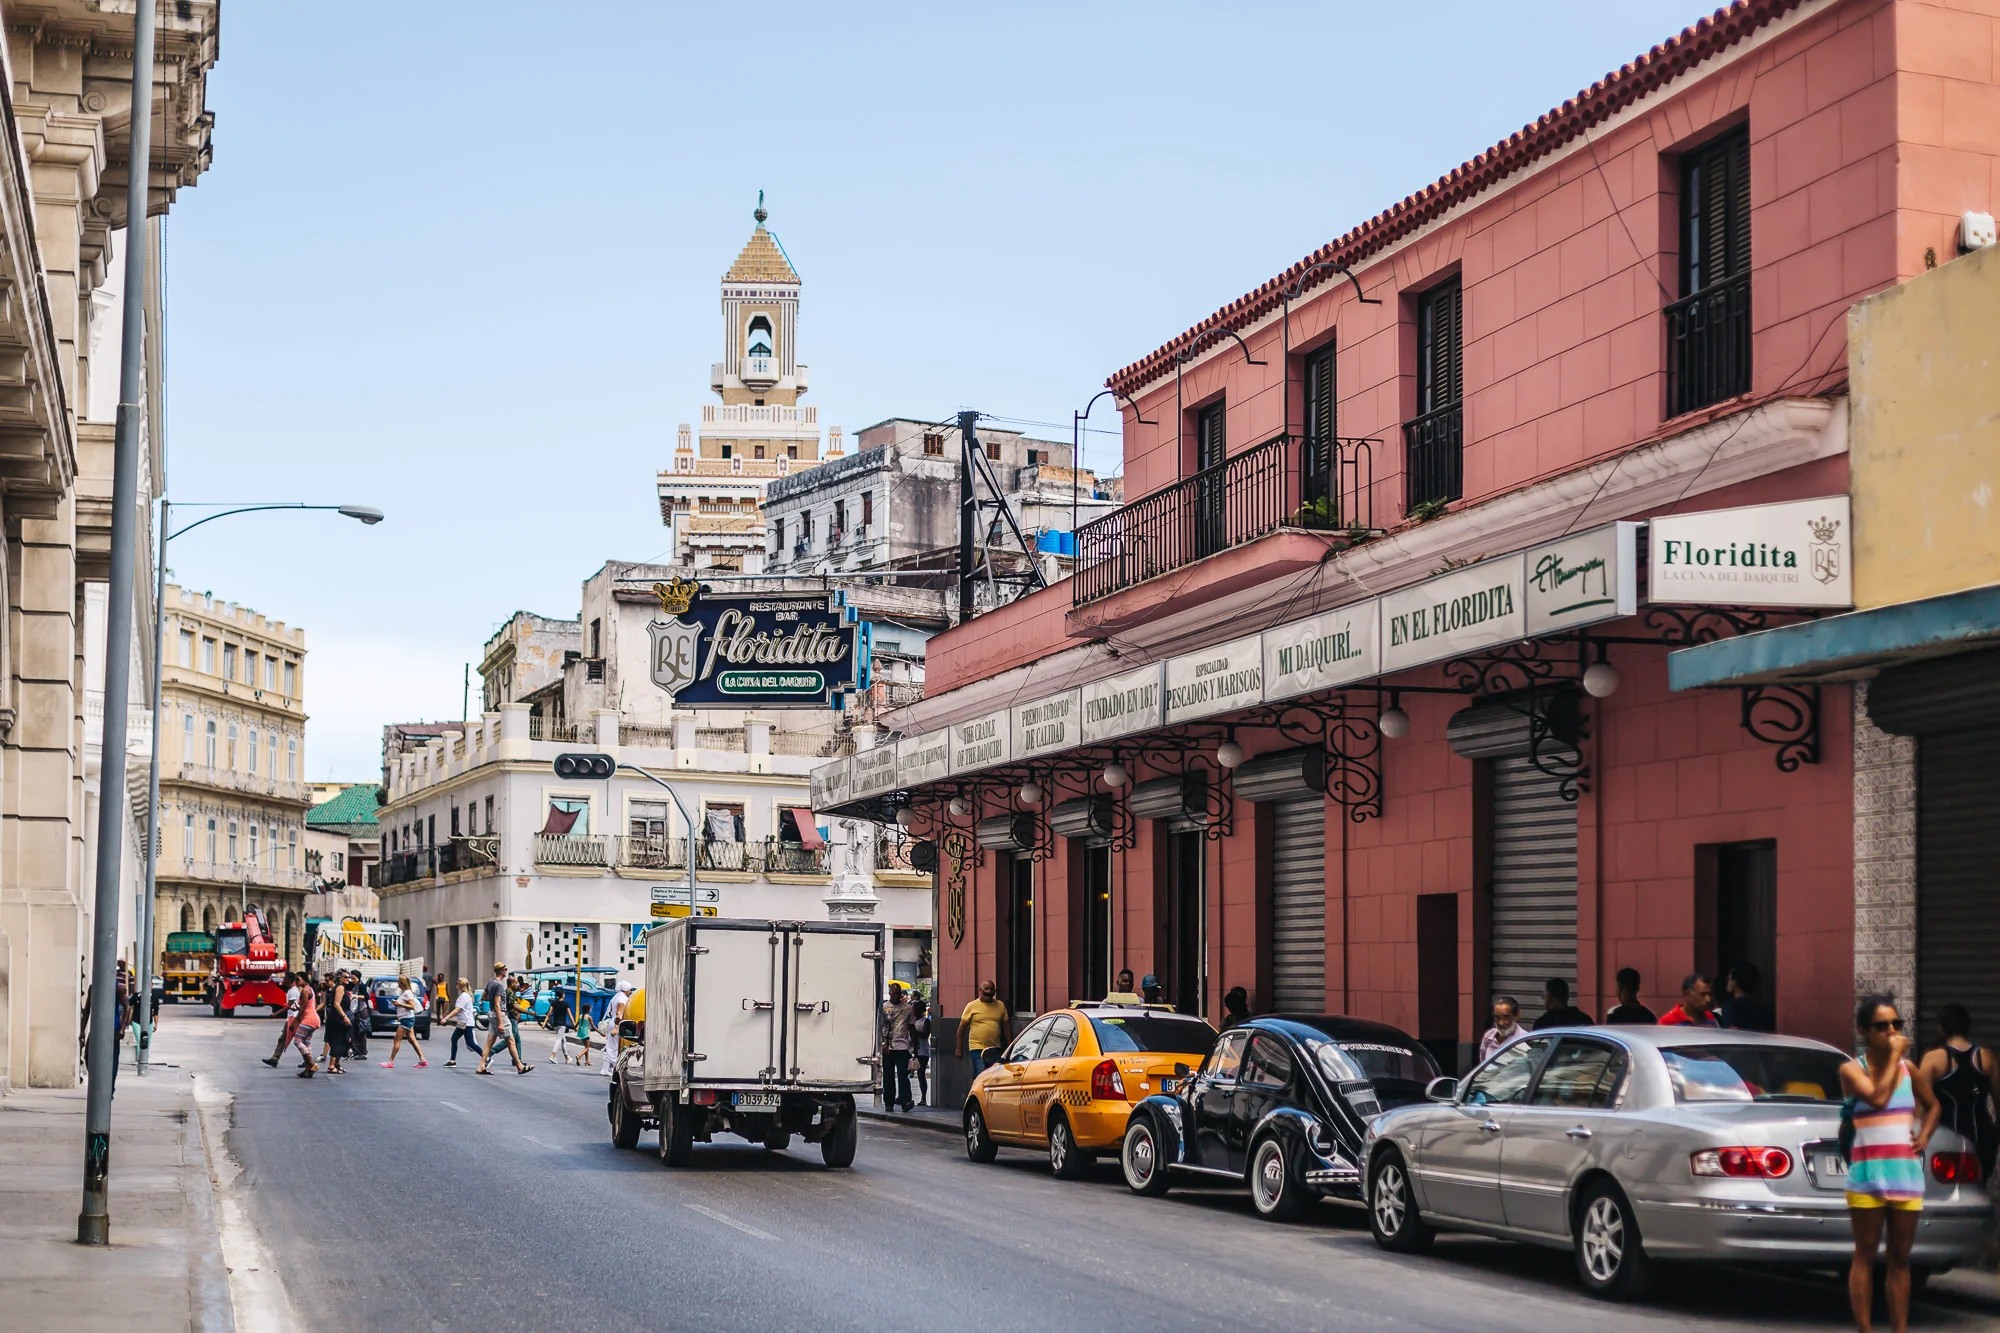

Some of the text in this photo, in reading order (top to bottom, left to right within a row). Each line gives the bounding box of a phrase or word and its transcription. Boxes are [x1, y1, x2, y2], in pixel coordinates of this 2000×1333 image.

[1663, 540, 1798, 568] Floridita
[1663, 570, 1678, 581] LA
[1681, 570, 1716, 582] CUNA
[1717, 571, 1740, 583] DEL
[1391, 583, 1514, 647] EN EL FLORIDITA
[1195, 657, 1229, 678] ESPECIALIDAD
[1278, 648, 1293, 677] MI
[761, 676, 779, 688] DEL
[1166, 667, 1261, 711] PESCADOS Y MARISCOS
[1021, 699, 1069, 728] PREMIO EUROPEO
[1086, 683, 1159, 724] FUNDADO EN 1817
[963, 719, 996, 745] THE CRADLE
[1025, 721, 1065, 750] DE CALIDAD
[956, 749, 964, 767] OF
[965, 746, 976, 765] THE
